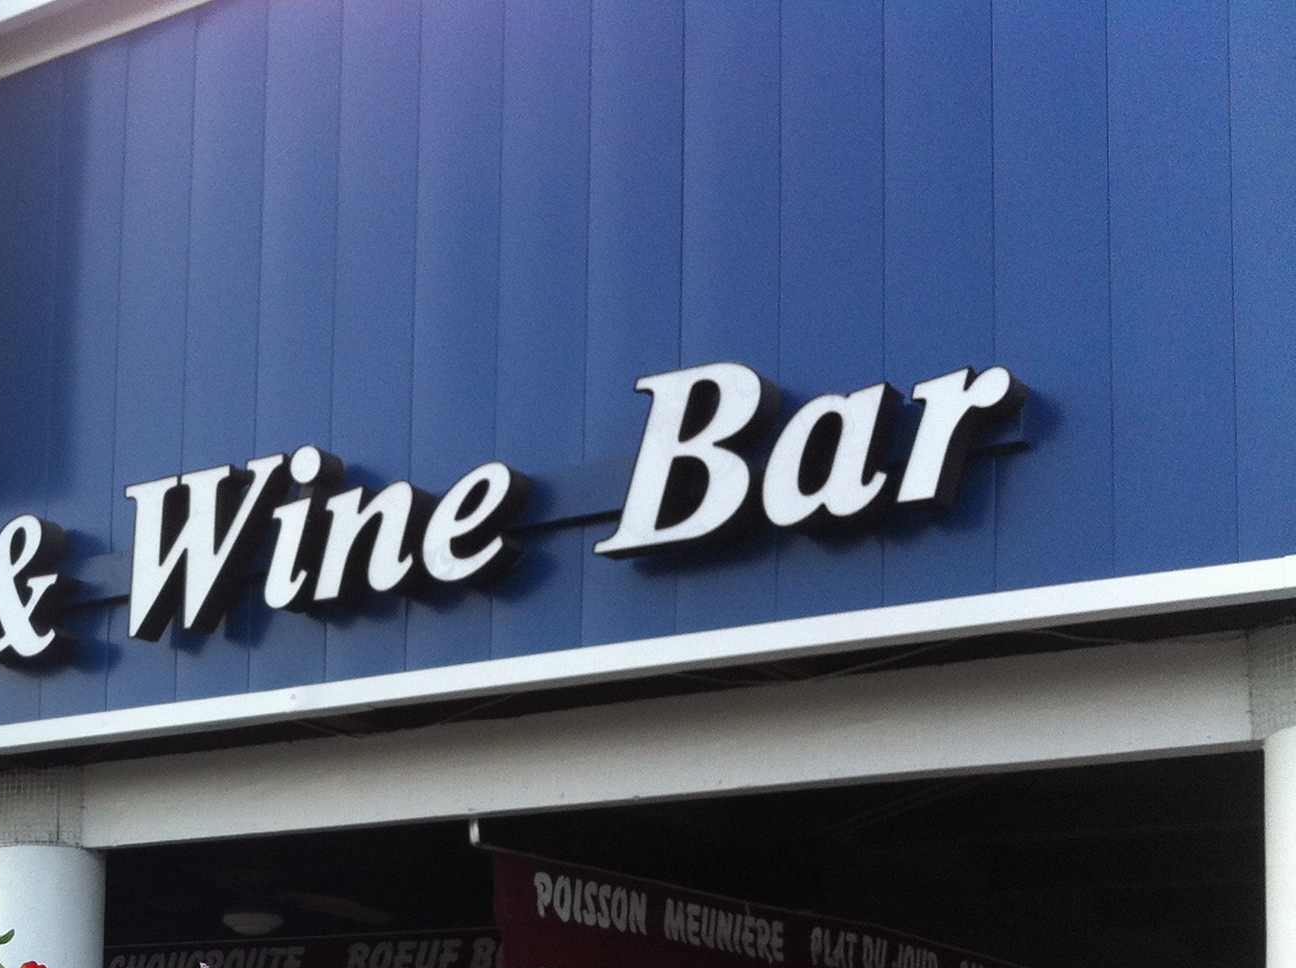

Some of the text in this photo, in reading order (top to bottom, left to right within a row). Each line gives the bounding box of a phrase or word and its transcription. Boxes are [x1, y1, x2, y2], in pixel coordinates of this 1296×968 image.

[124, 444, 512, 639] Wine
[592, 360, 1012, 556] Bar
[533, 871, 648, 936] POISSON
